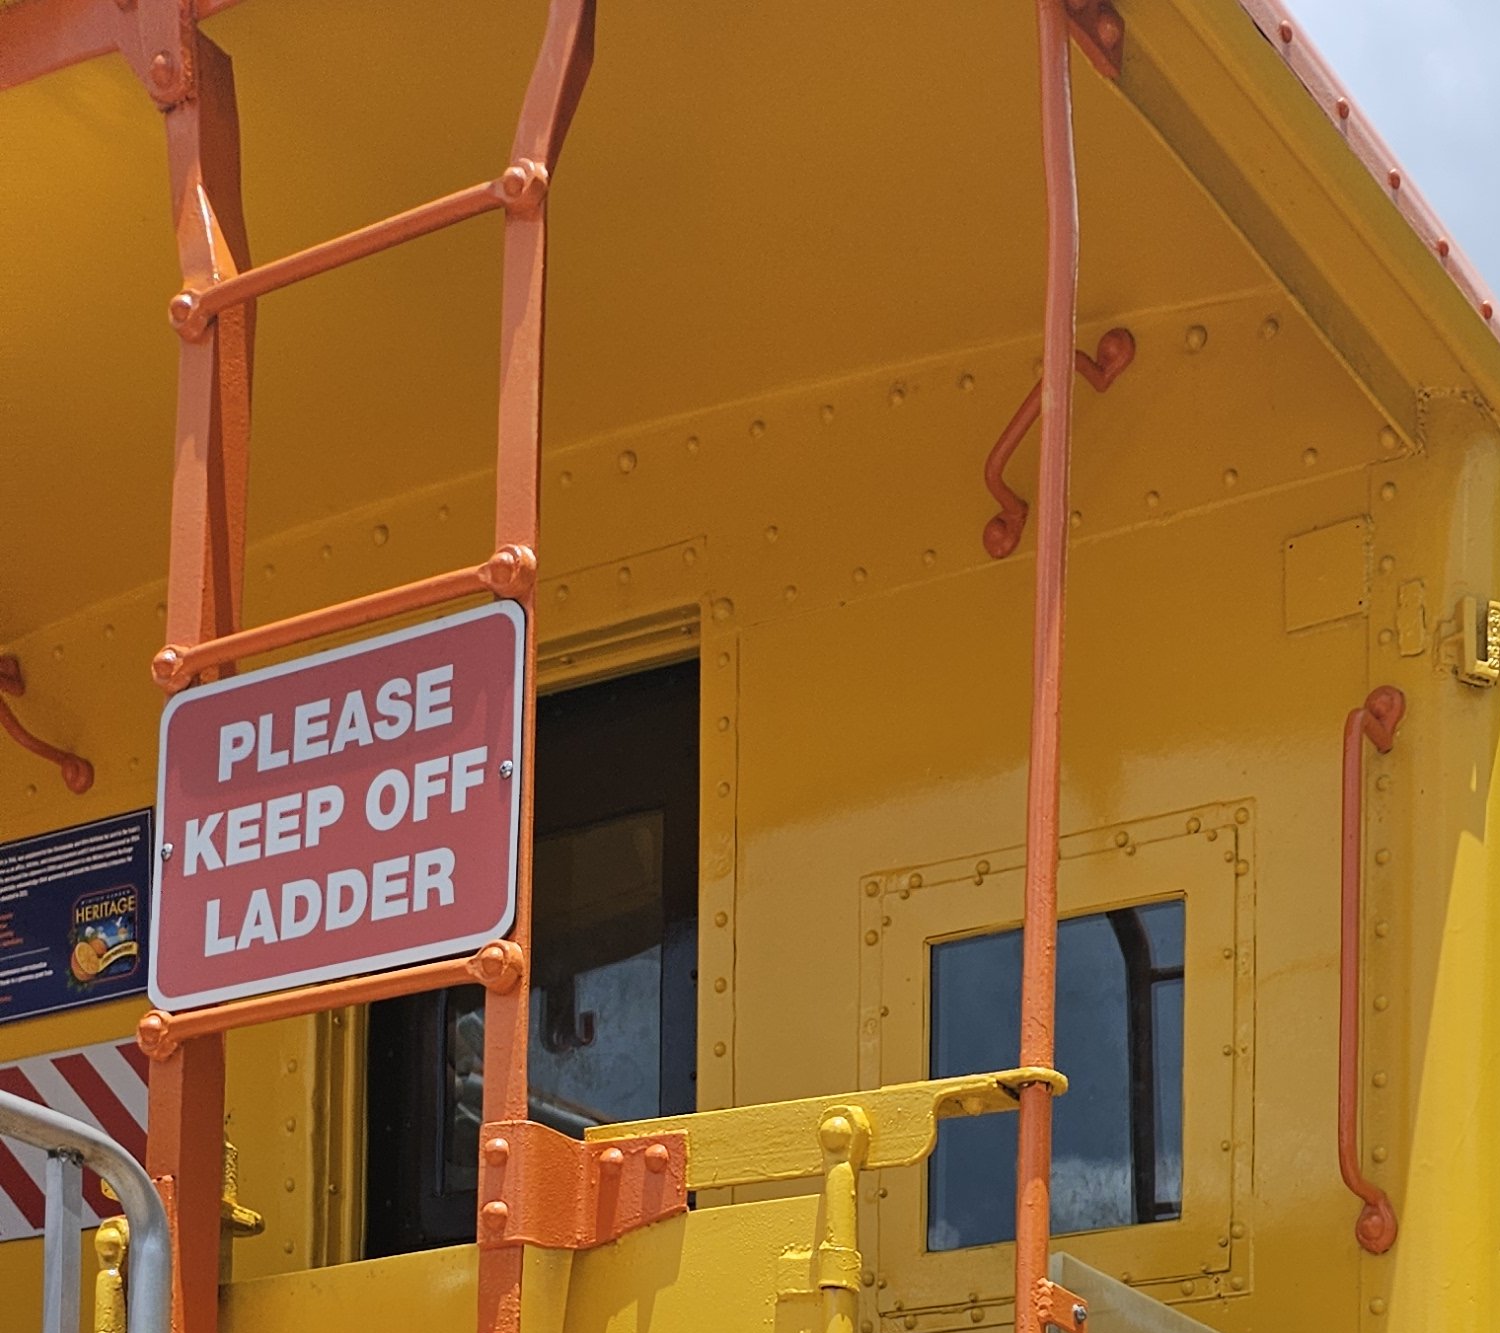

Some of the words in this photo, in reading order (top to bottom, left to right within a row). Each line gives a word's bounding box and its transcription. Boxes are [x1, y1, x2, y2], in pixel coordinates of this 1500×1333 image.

[218, 664, 454, 783] PLEASE
[183, 785, 345, 877] KEEP
[365, 746, 489, 831] OFF
[75, 895, 136, 923] HERITAGE
[204, 847, 456, 957] LADDER
